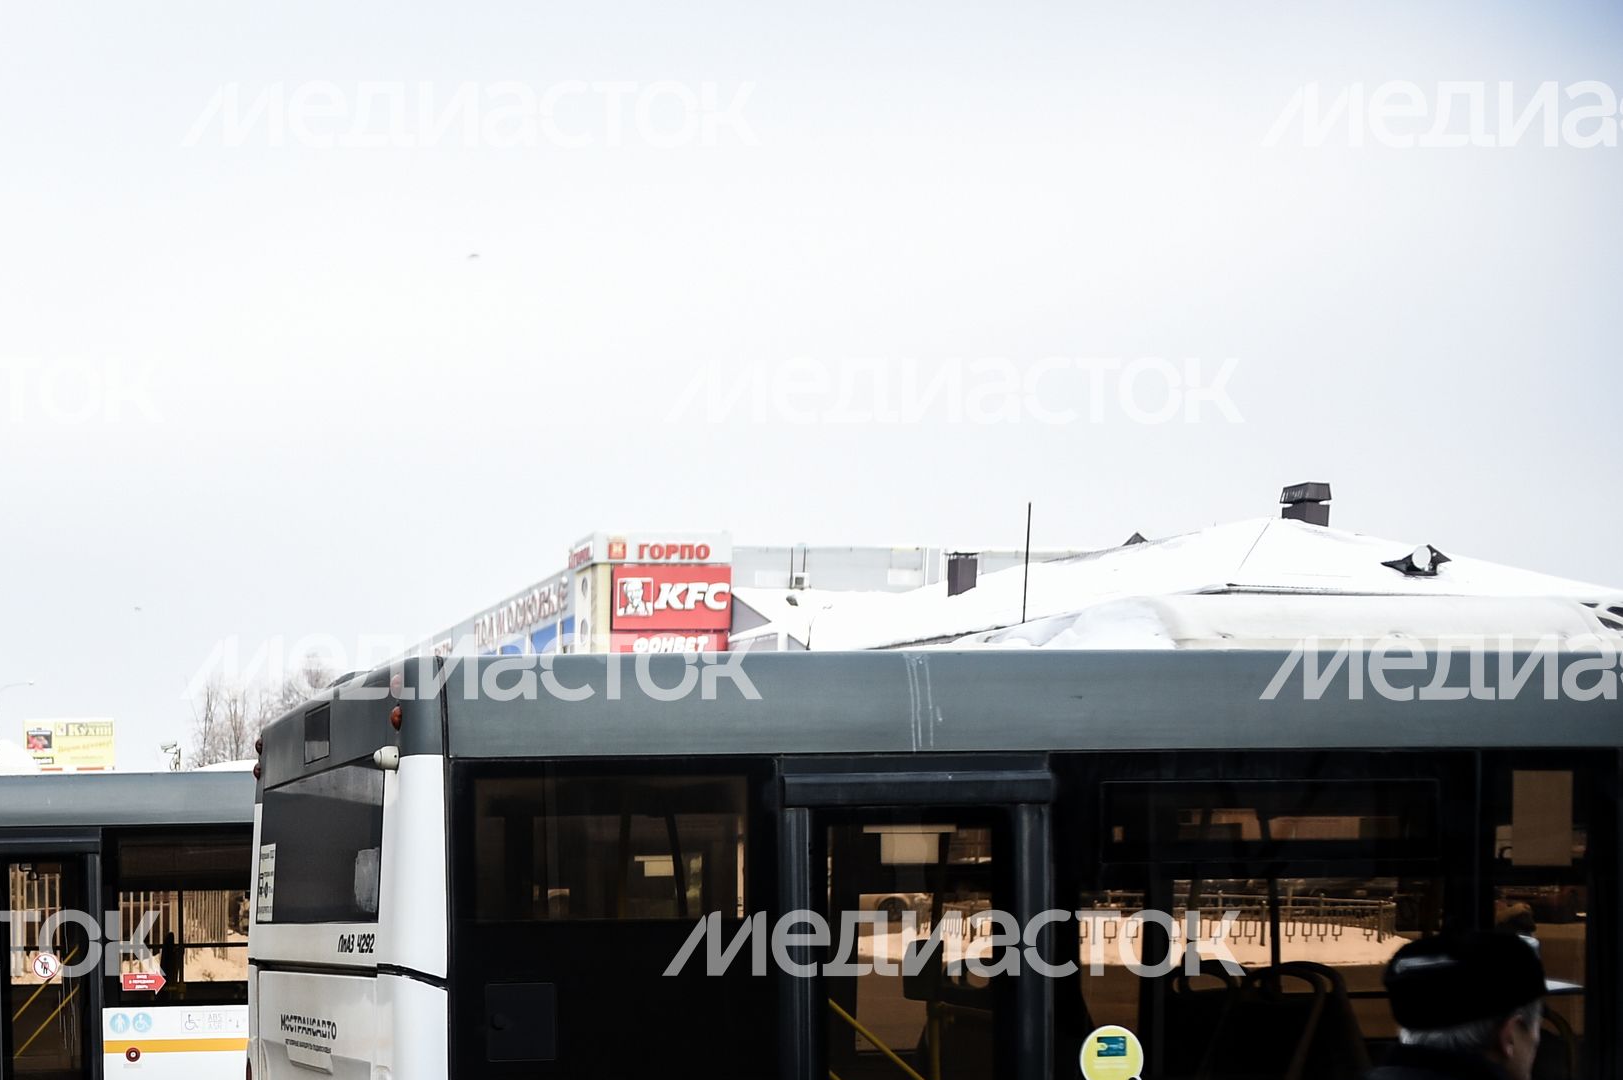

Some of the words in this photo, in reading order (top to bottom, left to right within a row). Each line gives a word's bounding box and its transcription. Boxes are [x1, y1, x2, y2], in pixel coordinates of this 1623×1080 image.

[637, 543, 711, 561] ГОРПО
[654, 582, 730, 611] KFC
[632, 635, 709, 653] ФОНБЕТ
[357, 933, 376, 954] 4292
[280, 1013, 337, 1040] МОСТРАНСАВТО
